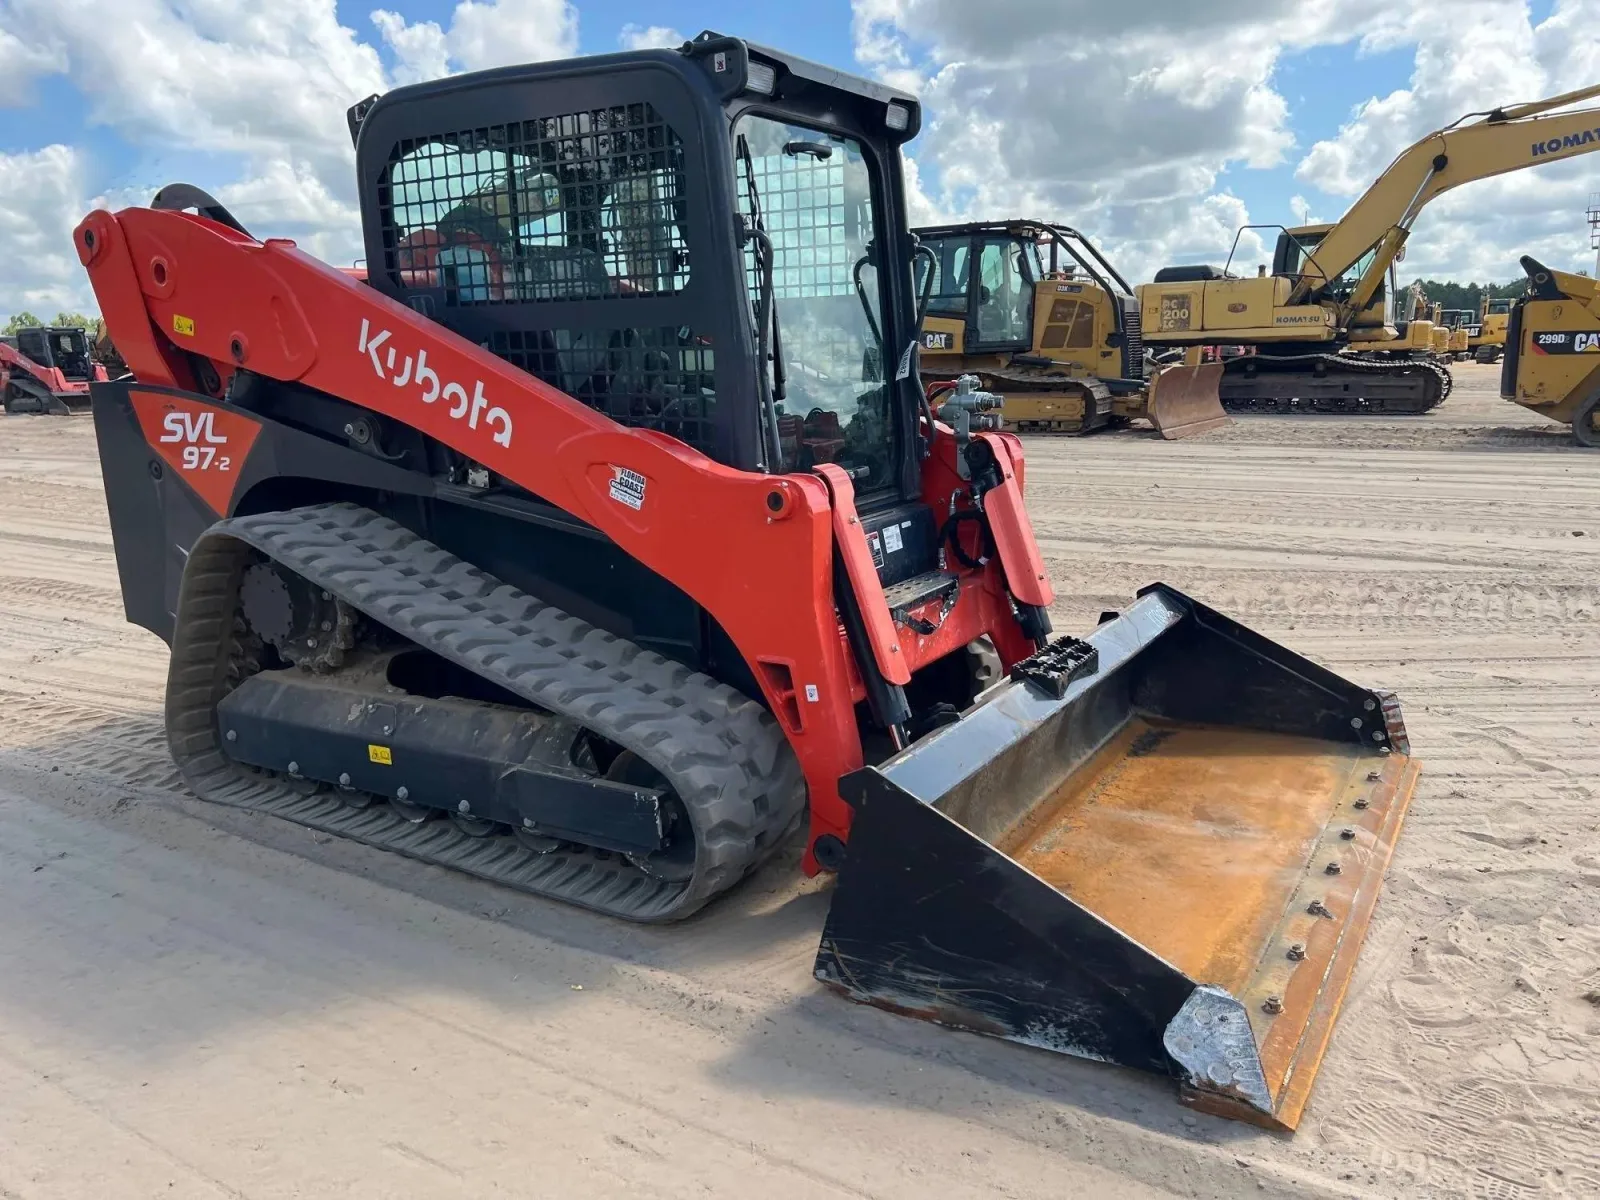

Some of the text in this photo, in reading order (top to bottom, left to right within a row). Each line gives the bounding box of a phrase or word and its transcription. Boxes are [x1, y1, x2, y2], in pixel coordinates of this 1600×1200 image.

[1163, 309, 1189, 319] 200
[926, 334, 946, 349] CAT
[1574, 333, 1600, 352] CA
[359, 318, 513, 449] Kubota
[160, 412, 227, 443] SVL
[182, 446, 230, 470] 97-2
[620, 477, 644, 494] COAST
[621, 469, 645, 486] FLORIDA
[612, 481, 642, 498] EQUIPMENT
